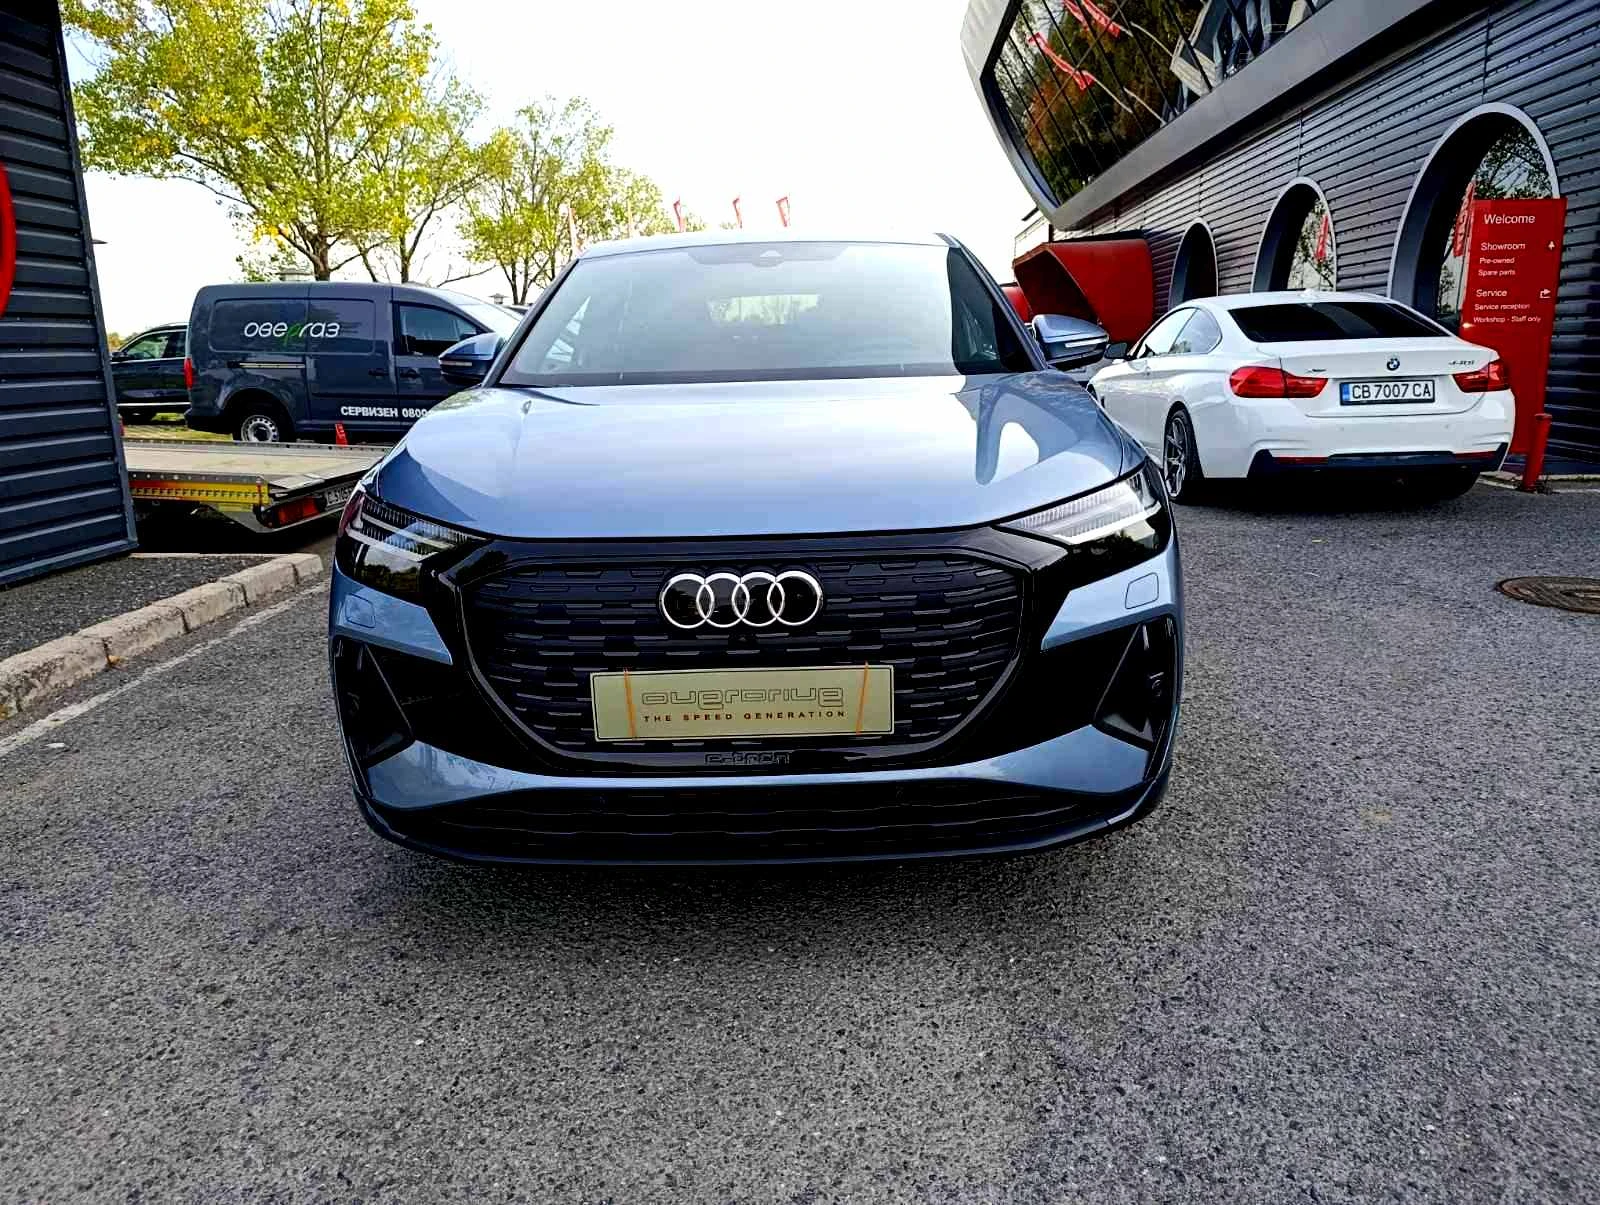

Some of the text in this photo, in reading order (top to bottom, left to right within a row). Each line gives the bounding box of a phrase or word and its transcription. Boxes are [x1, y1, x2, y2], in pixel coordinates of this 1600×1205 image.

[1483, 213, 1536, 225] Welcome
[1480, 242, 1526, 251] Showroom
[1478, 269, 1516, 277] Spare parts
[1476, 289, 1508, 298] Service
[1474, 303, 1530, 312] Service reception
[1473, 315, 1506, 323] Workshop
[1511, 315, 1527, 323] Staff
[1527, 315, 1541, 324] only
[1352, 383, 1432, 399] CB 7007 CA
[340, 406, 399, 418] СЕРВИЗЕН
[643, 711, 845, 723] THE SPEED GENERATION
